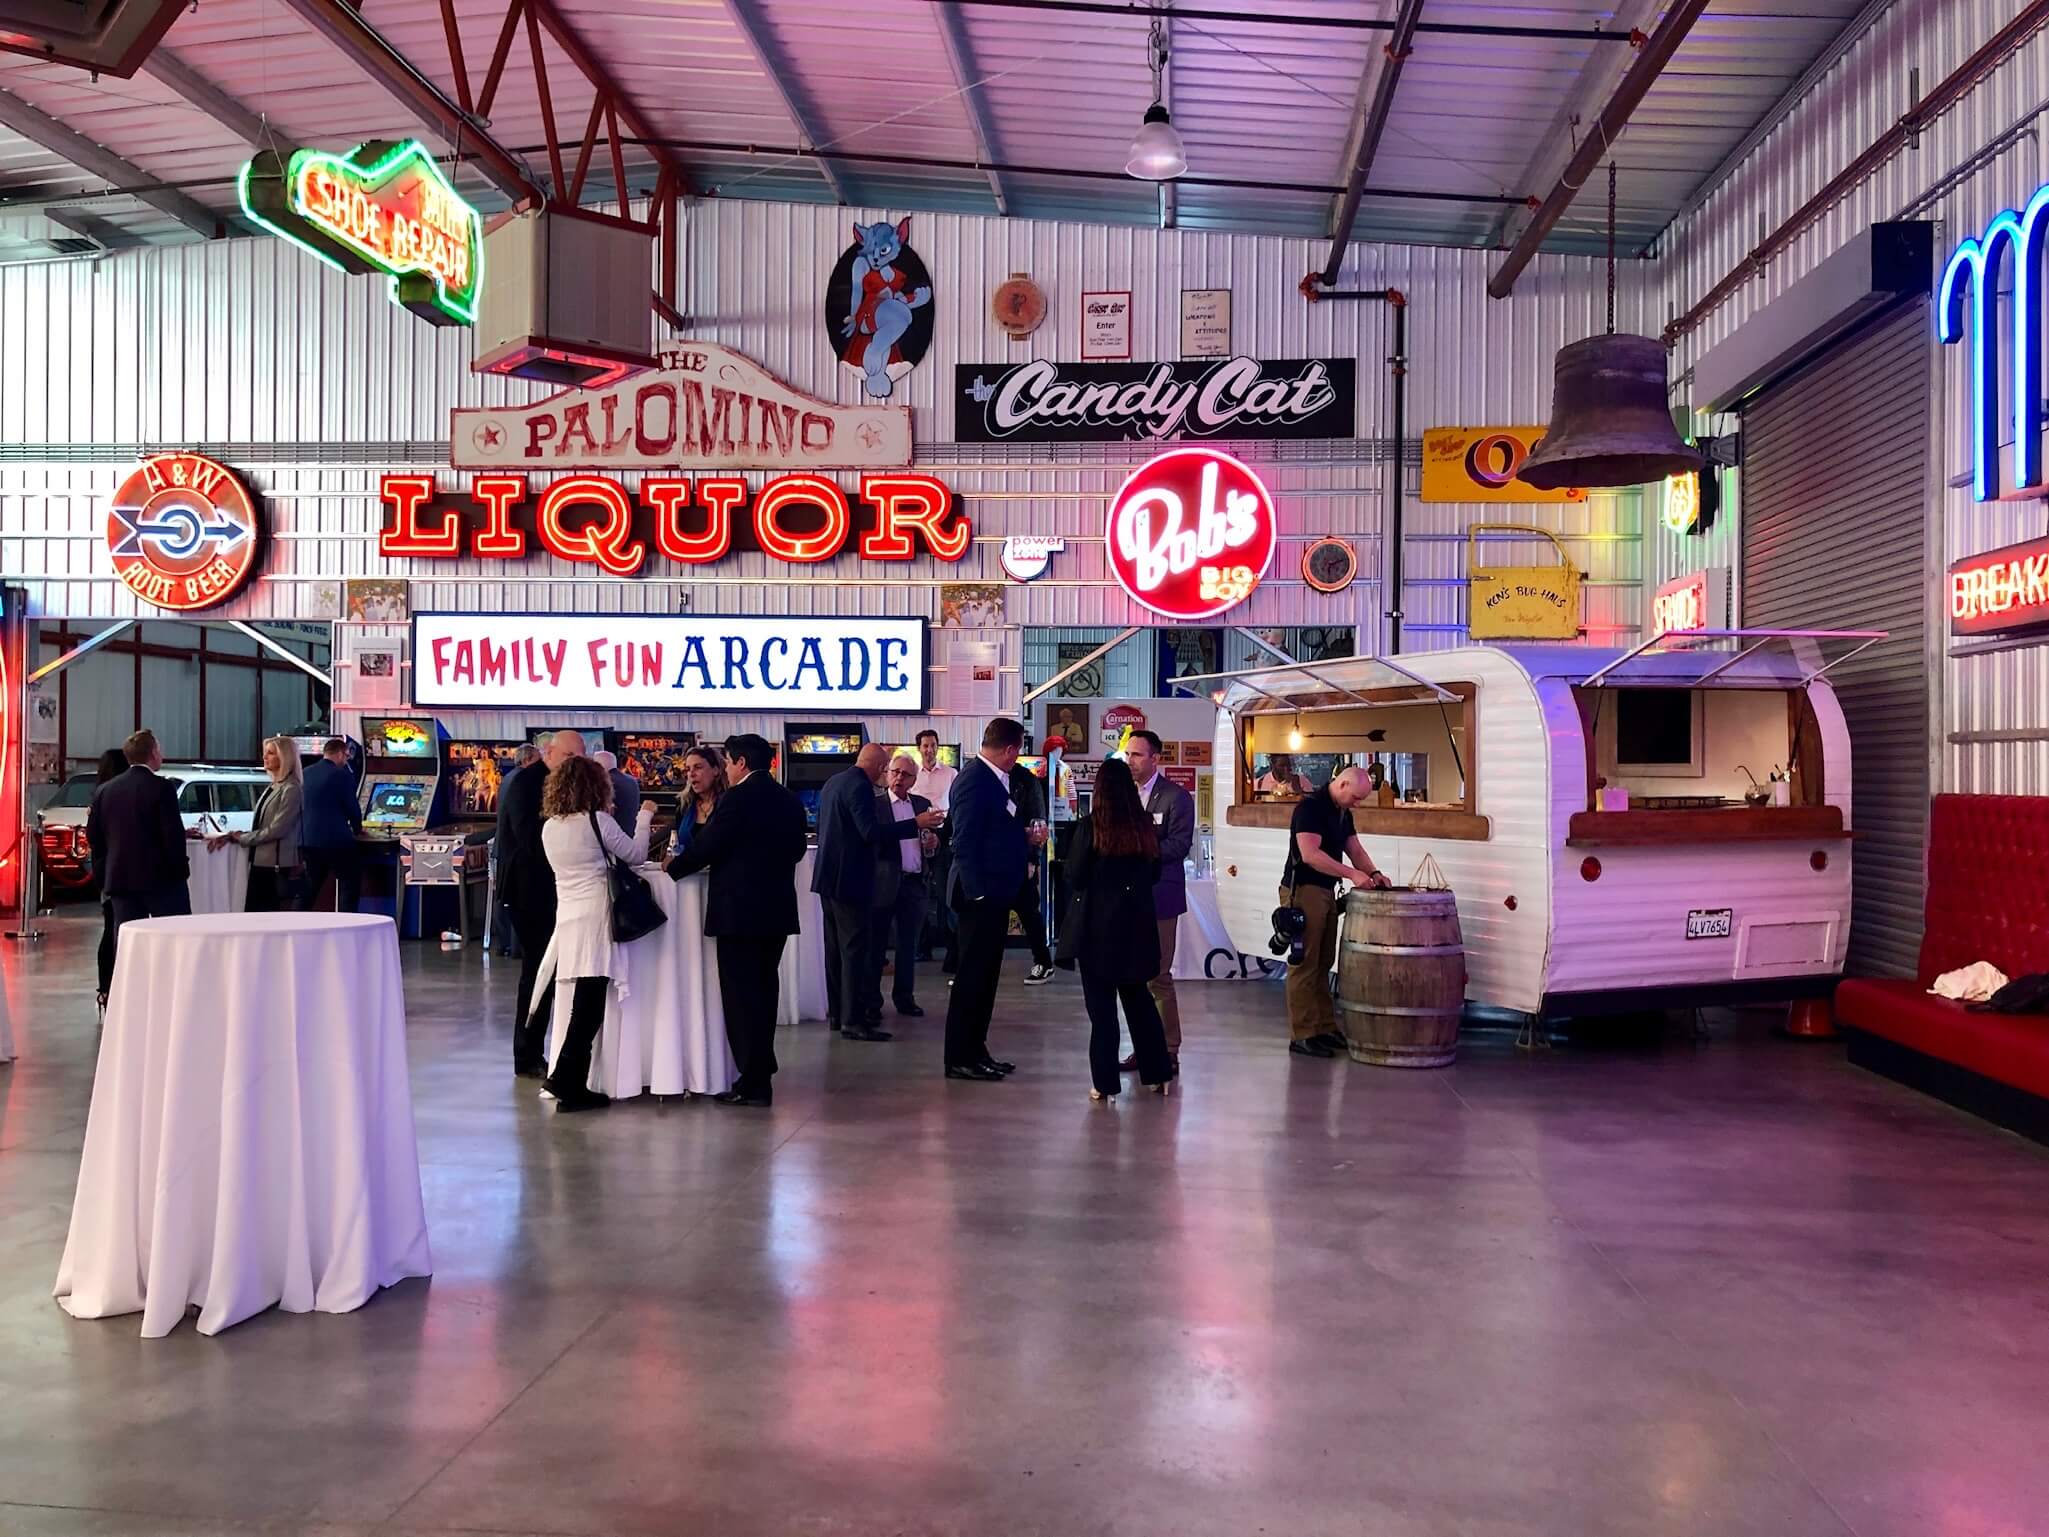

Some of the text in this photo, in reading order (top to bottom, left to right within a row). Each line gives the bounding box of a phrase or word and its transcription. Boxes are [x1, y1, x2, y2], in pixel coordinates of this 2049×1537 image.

[311, 174, 381, 246] SHOE
[392, 213, 468, 287] REPAIR
[656, 350, 708, 373] THE
[990, 356, 1198, 437] Candy
[1192, 356, 1336, 432] Cat
[523, 377, 835, 458] PALOMINO
[380, 473, 972, 577] LIQUOR
[1012, 536, 1064, 549] power
[123, 559, 237, 603] ROOT BEER
[1200, 566, 1253, 583] BIG
[1200, 582, 1250, 602] BOY
[1486, 586, 1567, 609] KEN'S BUG HAUS
[432, 636, 567, 687] FAMILY
[587, 636, 663, 687] FUN
[672, 636, 909, 692] ARCADE
[1106, 712, 1144, 726] Carnation
